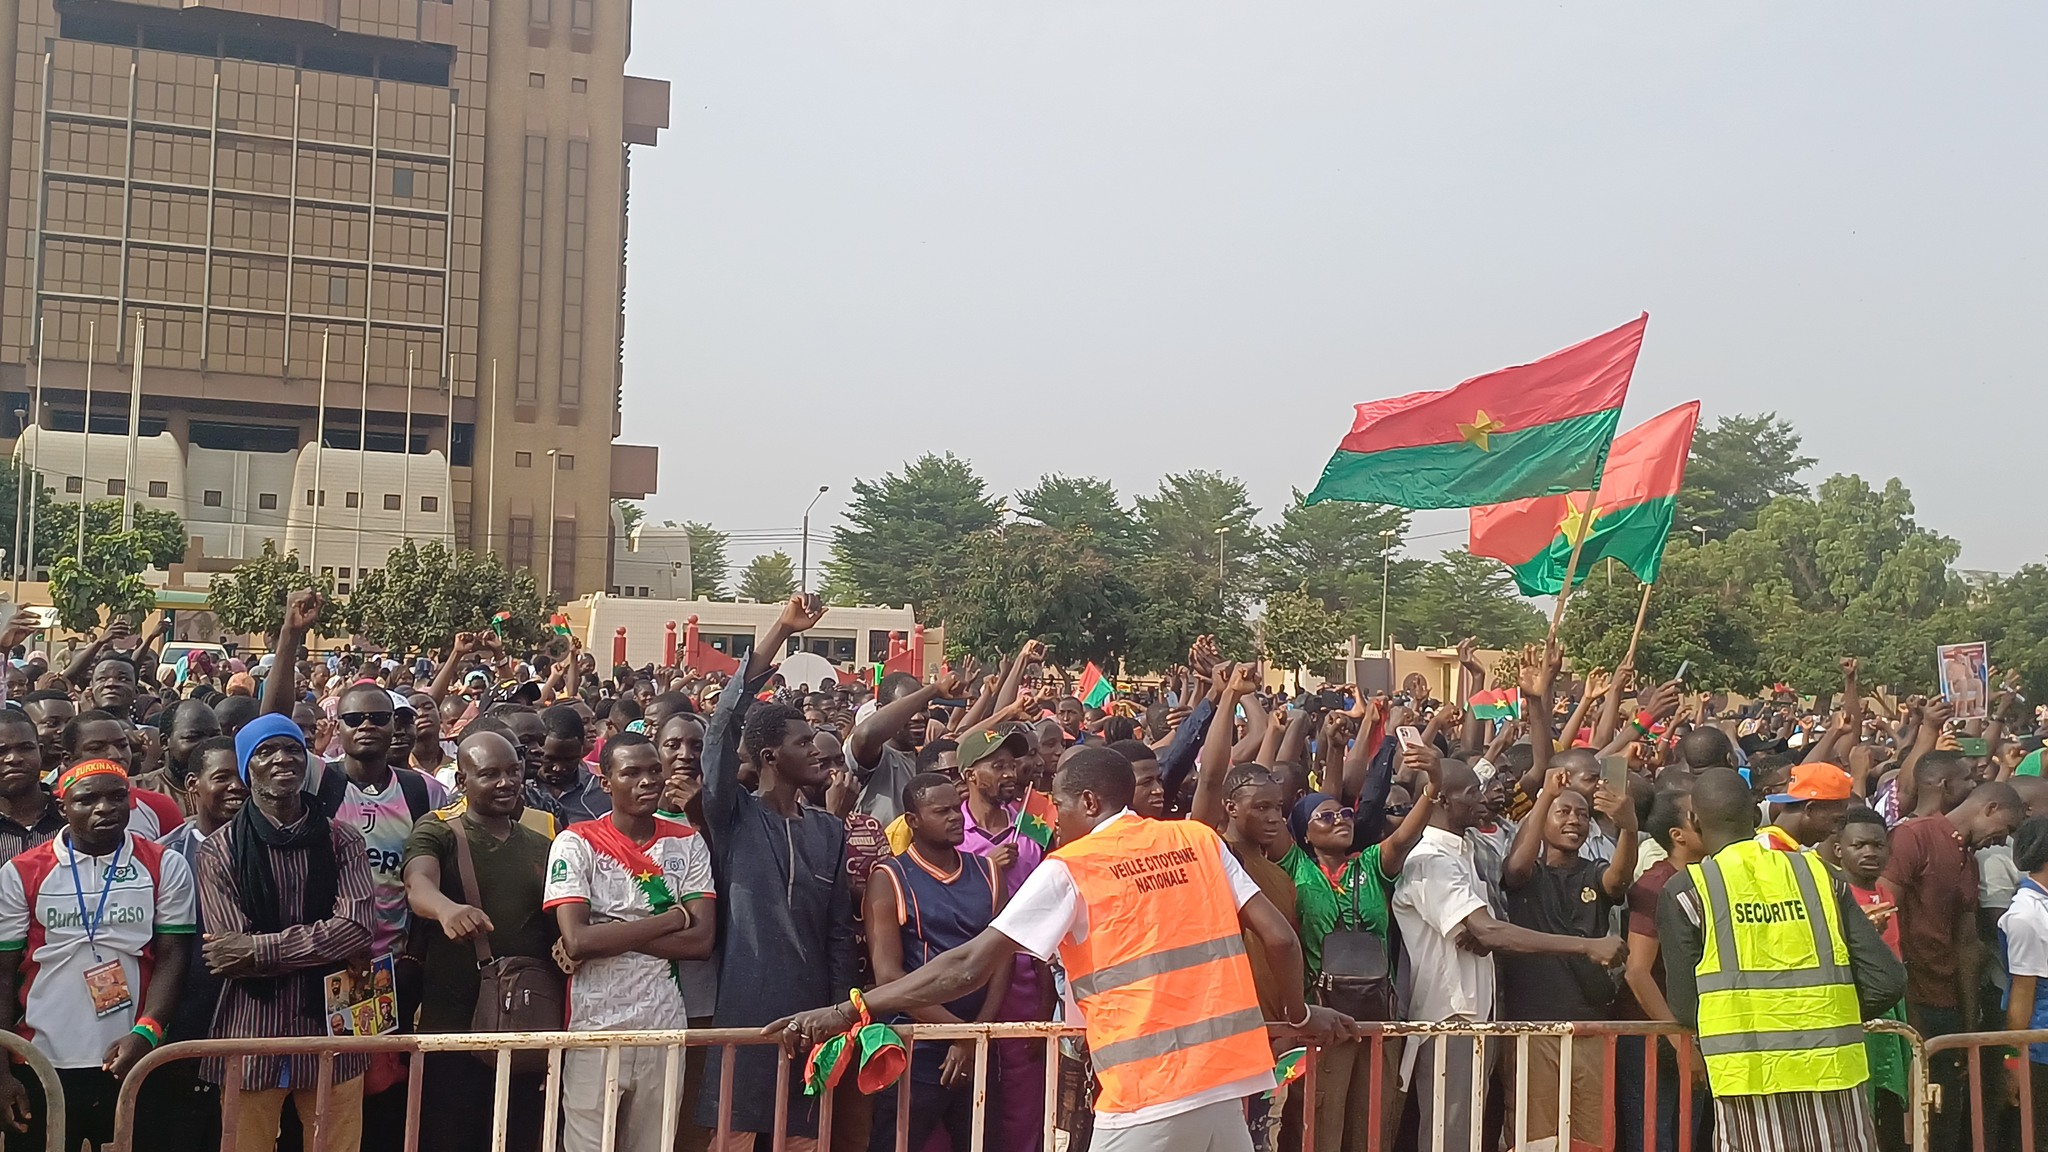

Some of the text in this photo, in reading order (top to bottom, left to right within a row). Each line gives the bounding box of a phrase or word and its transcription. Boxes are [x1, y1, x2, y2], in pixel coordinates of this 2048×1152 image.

[75, 762, 112, 778] BURKINA
[1109, 847, 1198, 880] VEILLE CITOYENNE
[1135, 868, 1189, 894] NATIONALE
[47, 903, 144, 930] Burkn Faso
[1735, 900, 1805, 924] SECURITE
